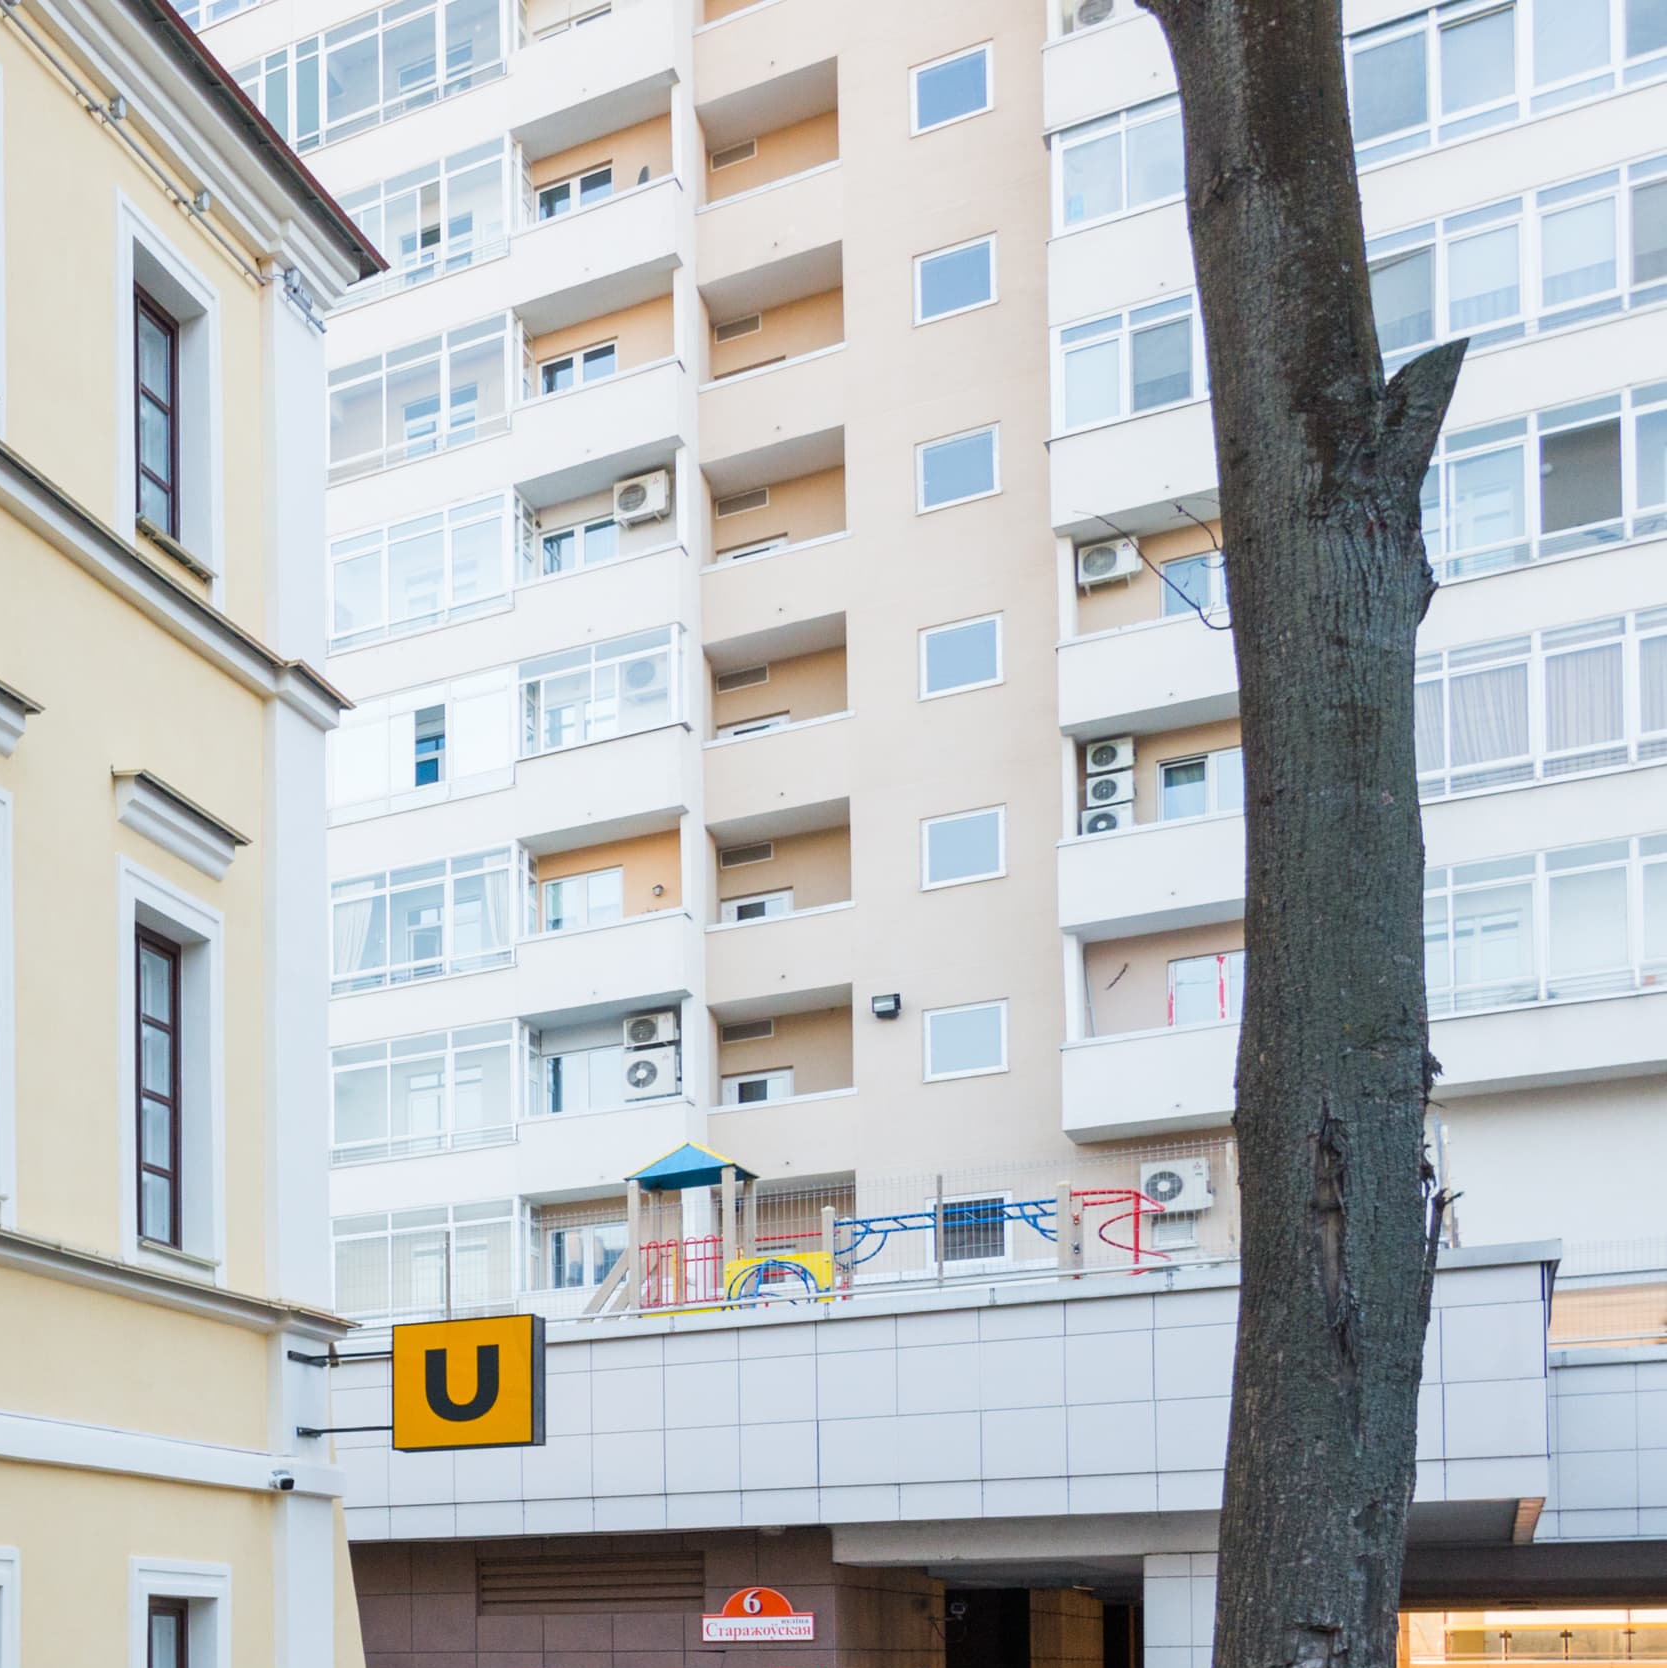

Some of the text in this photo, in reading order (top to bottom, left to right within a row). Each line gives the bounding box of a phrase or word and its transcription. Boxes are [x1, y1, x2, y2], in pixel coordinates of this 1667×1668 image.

[425, 1344, 499, 1422] U
[743, 1590, 763, 1615] 6
[705, 1622, 811, 1640] Старажоўская
